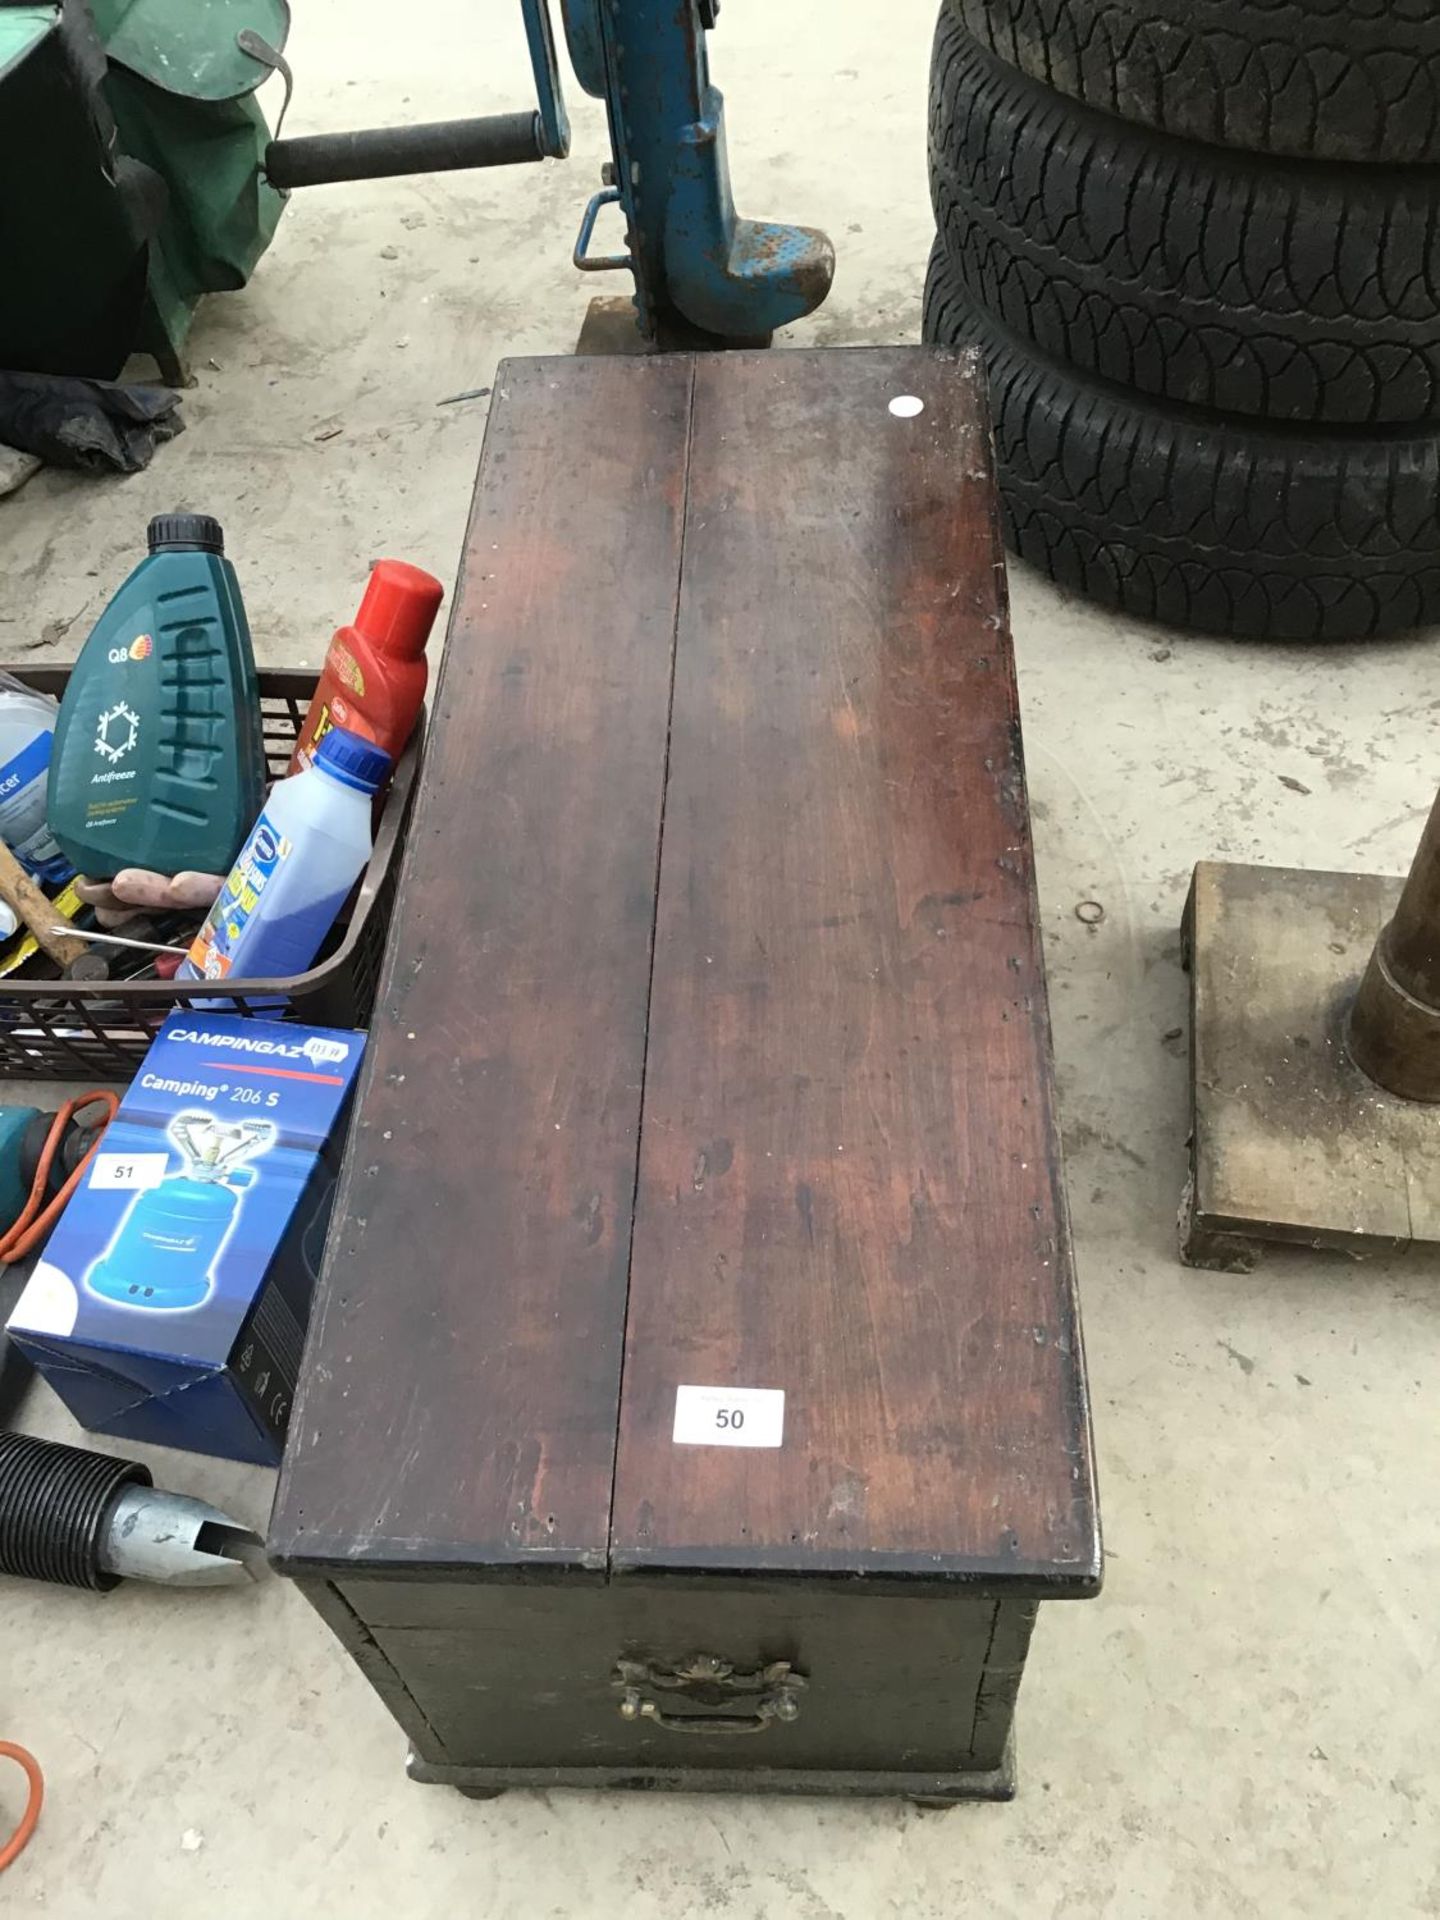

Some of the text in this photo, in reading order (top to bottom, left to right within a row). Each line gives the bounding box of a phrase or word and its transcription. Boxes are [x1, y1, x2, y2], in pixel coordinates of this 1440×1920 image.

[108, 647, 128, 663] Q8
[91, 771, 136, 785] Antifreeze
[167, 1029, 304, 1058] CAMPINGAZ
[230, 1087, 261, 1104] 206
[265, 1092, 280, 1107] S
[114, 1166, 133, 1178] 51
[715, 1409, 744, 1429] 50
